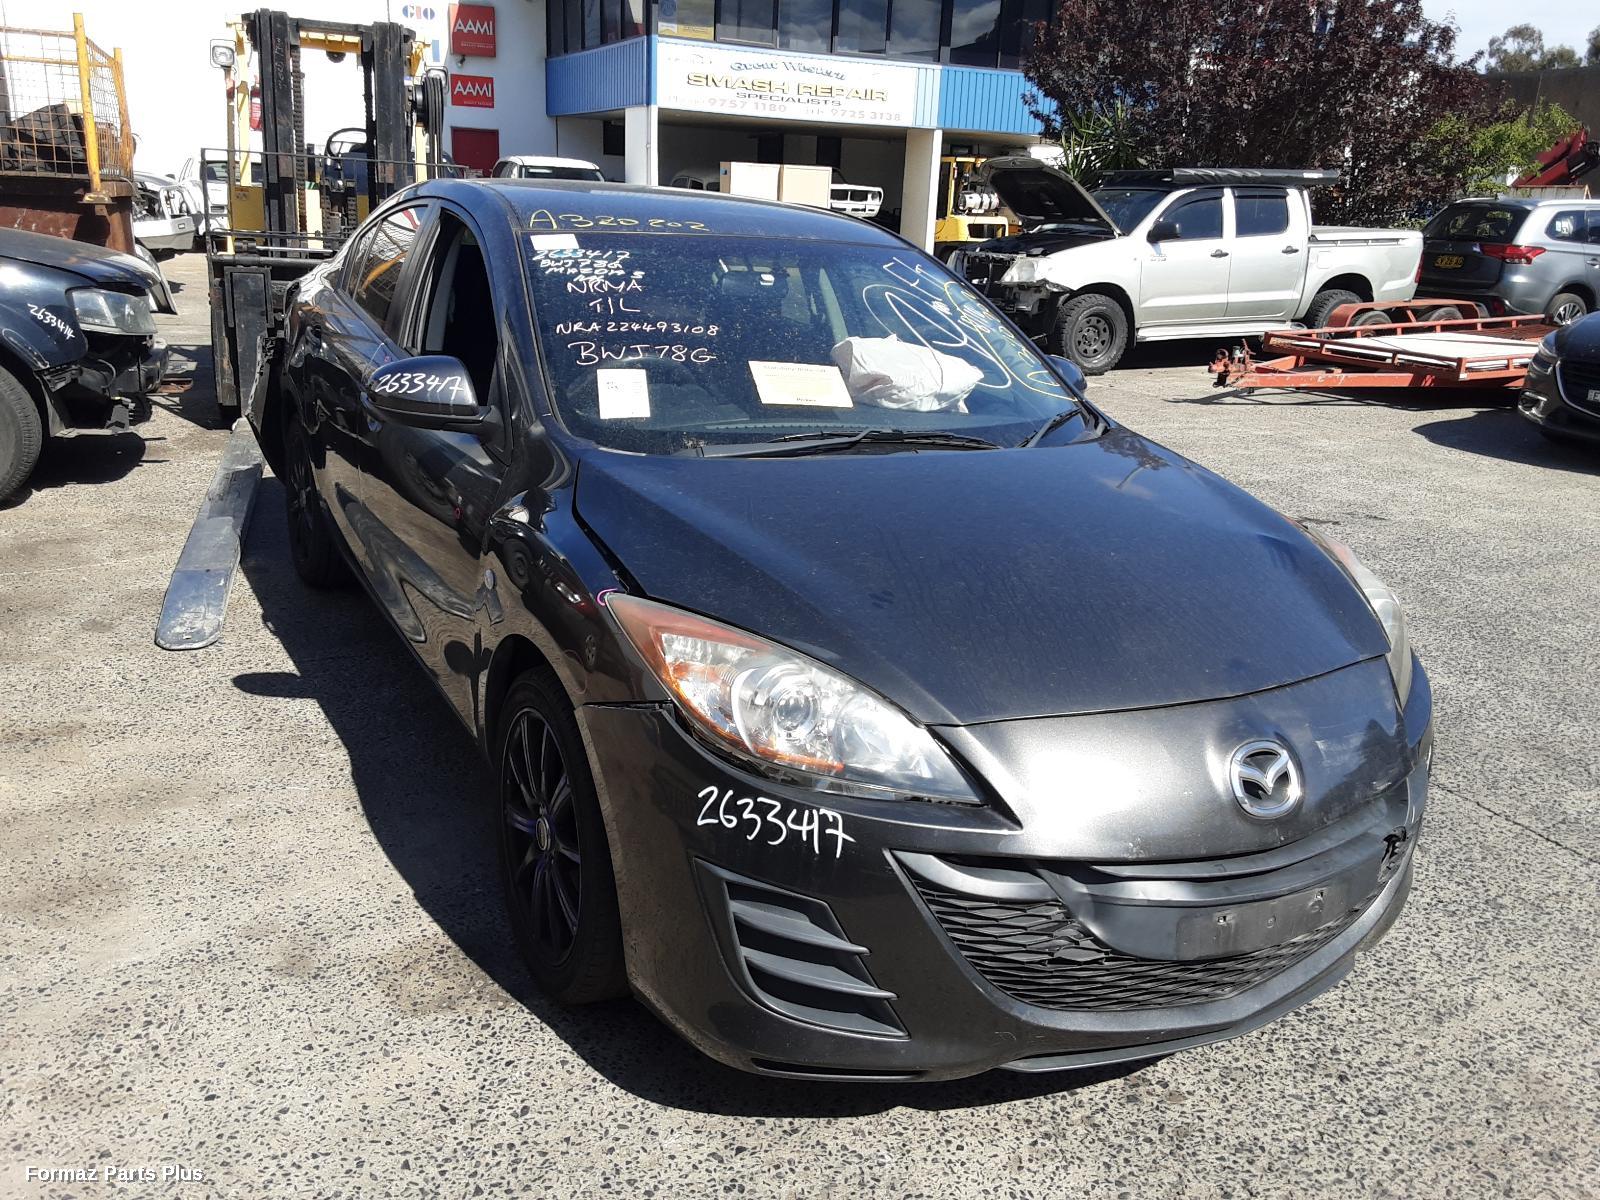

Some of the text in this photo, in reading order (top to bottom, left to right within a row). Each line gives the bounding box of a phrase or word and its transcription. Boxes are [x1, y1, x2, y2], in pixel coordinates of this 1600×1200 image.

[454, 18, 493, 36] AAMI
[453, 80, 492, 97] AAMI
[687, 73, 888, 102] SMASH REPAIR
[707, 98, 748, 109] 9757
[736, 92, 842, 106] SPECIALISTS
[566, 279, 643, 293] NRMA
[375, 372, 465, 401] 2633417
[697, 785, 857, 859] 2633417
